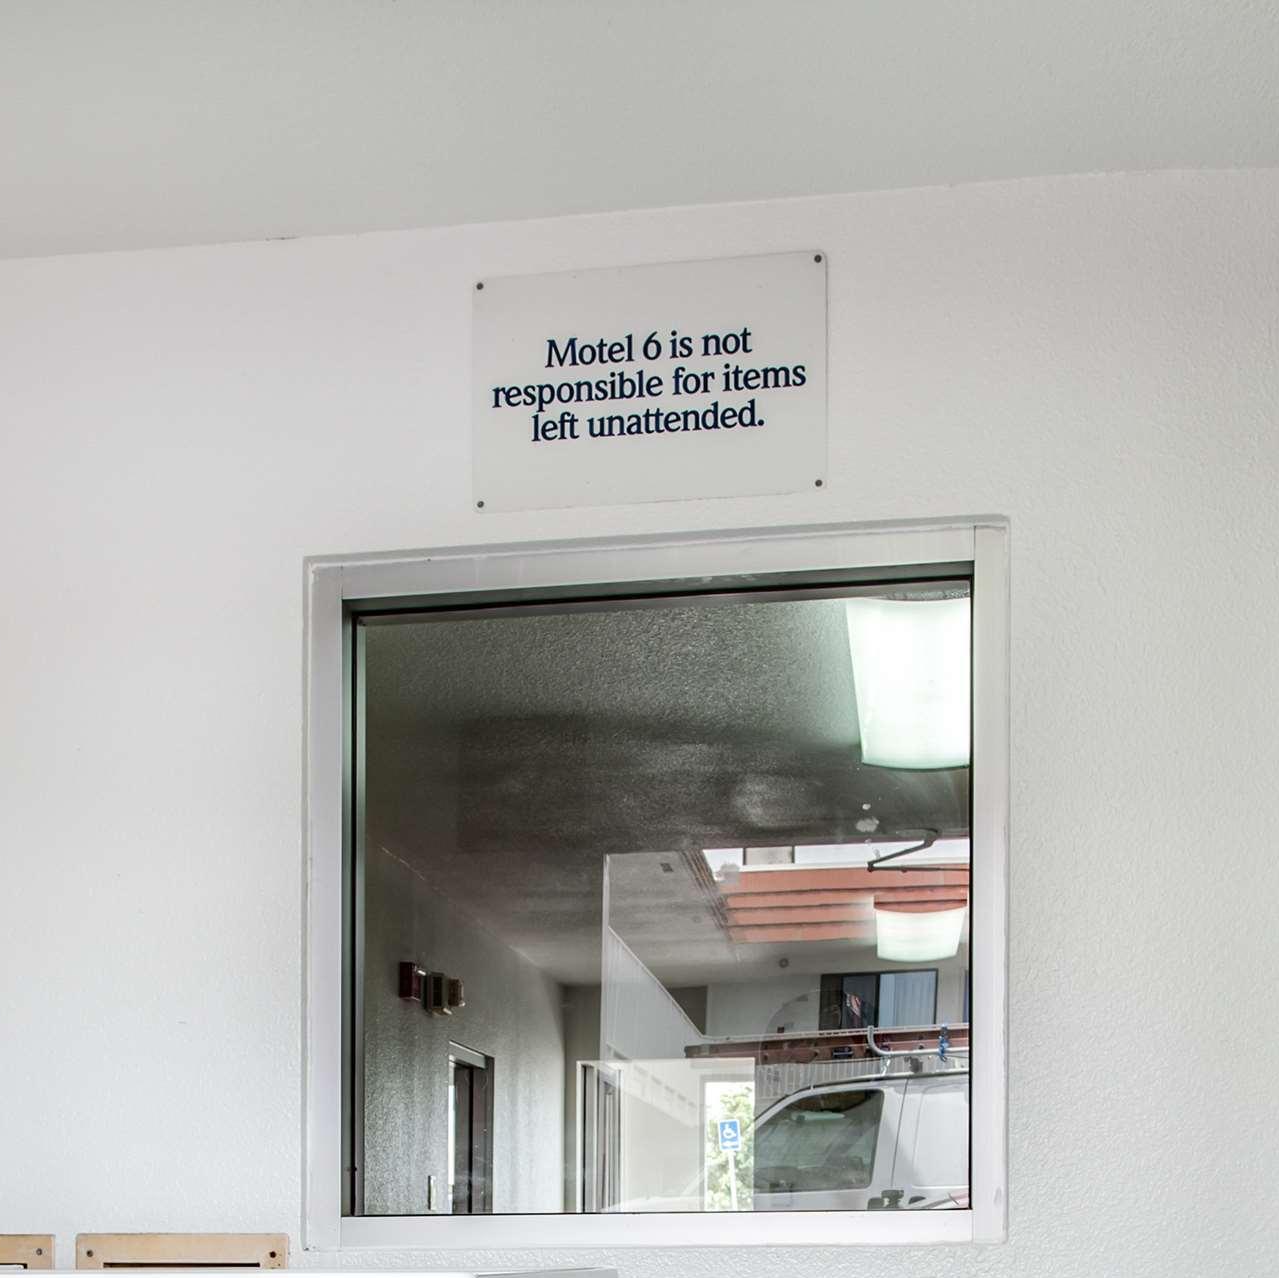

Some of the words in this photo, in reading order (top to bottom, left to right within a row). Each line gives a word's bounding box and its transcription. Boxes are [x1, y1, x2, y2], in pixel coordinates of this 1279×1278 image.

[545, 334, 634, 368] Motel
[642, 331, 662, 360] 6
[669, 330, 693, 358] is
[702, 326, 752, 356] not
[492, 370, 663, 412] responsible
[672, 366, 715, 395] for
[723, 363, 807, 391] items
[532, 411, 580, 442] left
[587, 399, 764, 438] unattended.
